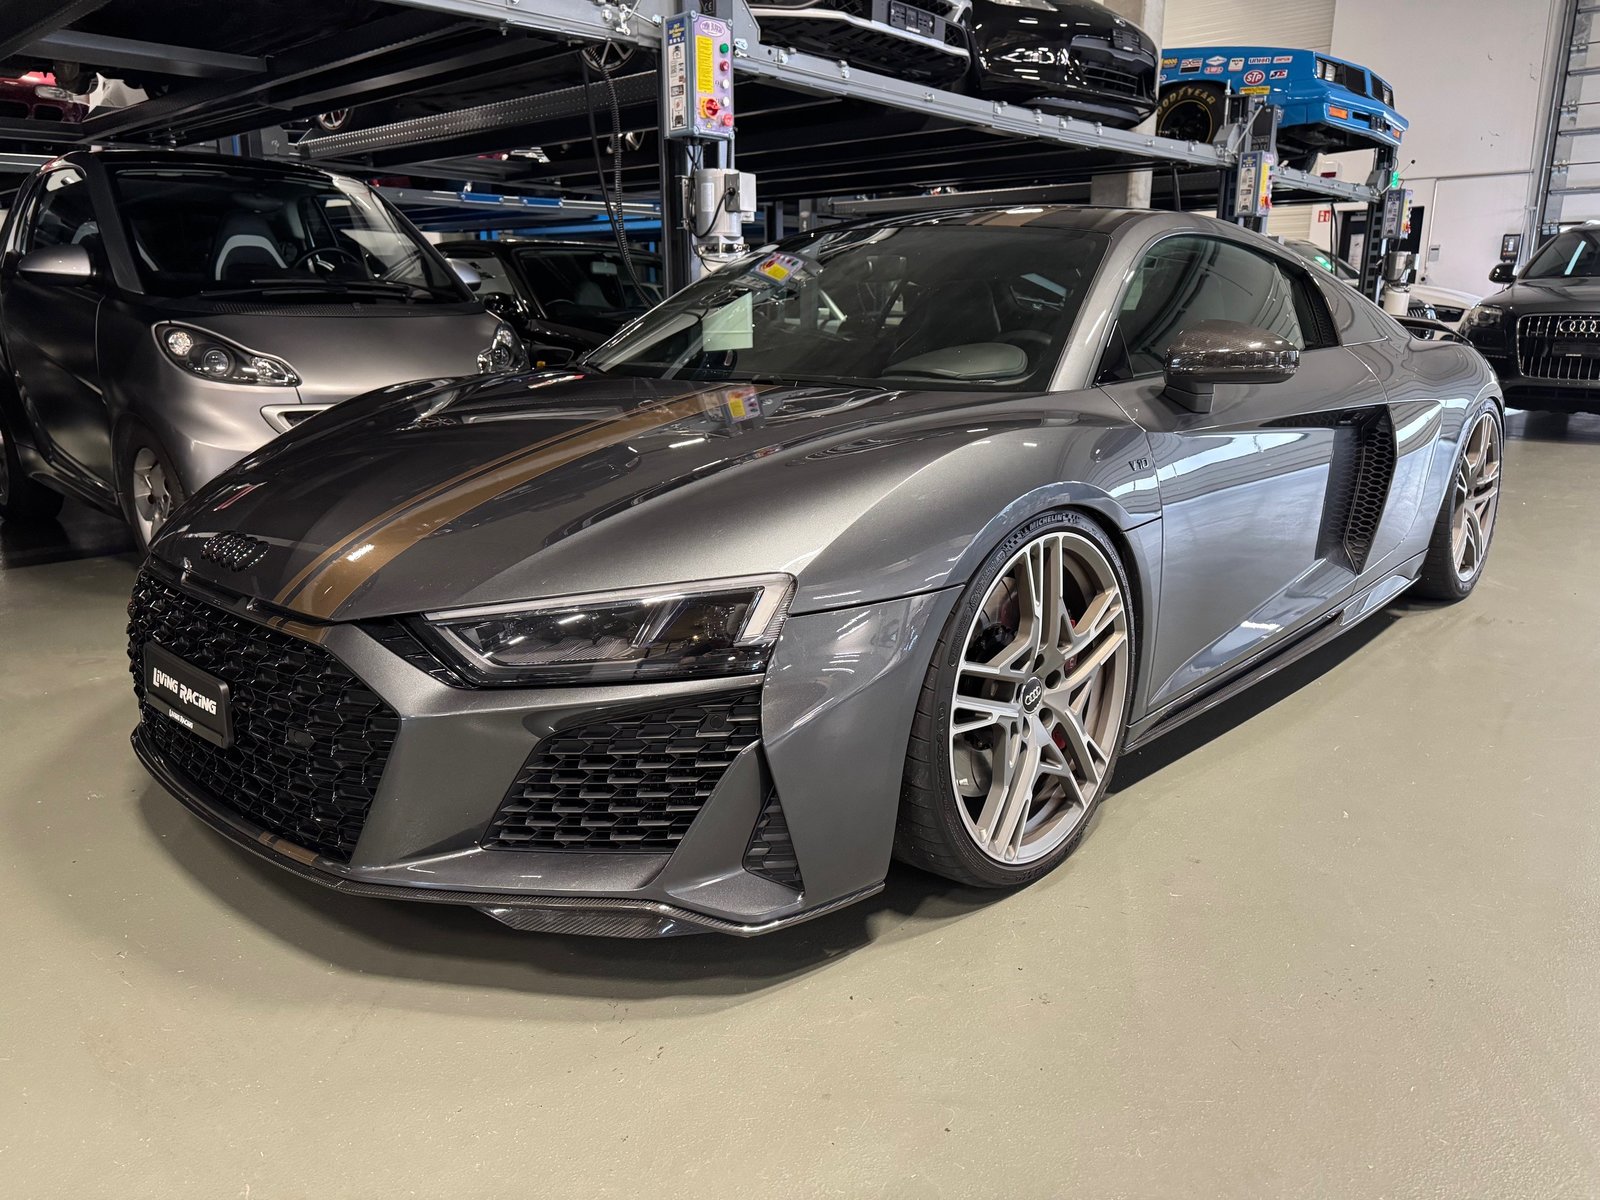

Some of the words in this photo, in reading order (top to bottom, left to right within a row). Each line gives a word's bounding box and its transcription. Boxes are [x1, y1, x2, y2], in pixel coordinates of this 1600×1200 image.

[1246, 71, 1263, 83] STP
[1157, 85, 1216, 115] OODYEAR
[1128, 457, 1149, 471] V10
[1029, 513, 1063, 530] MICHELIN
